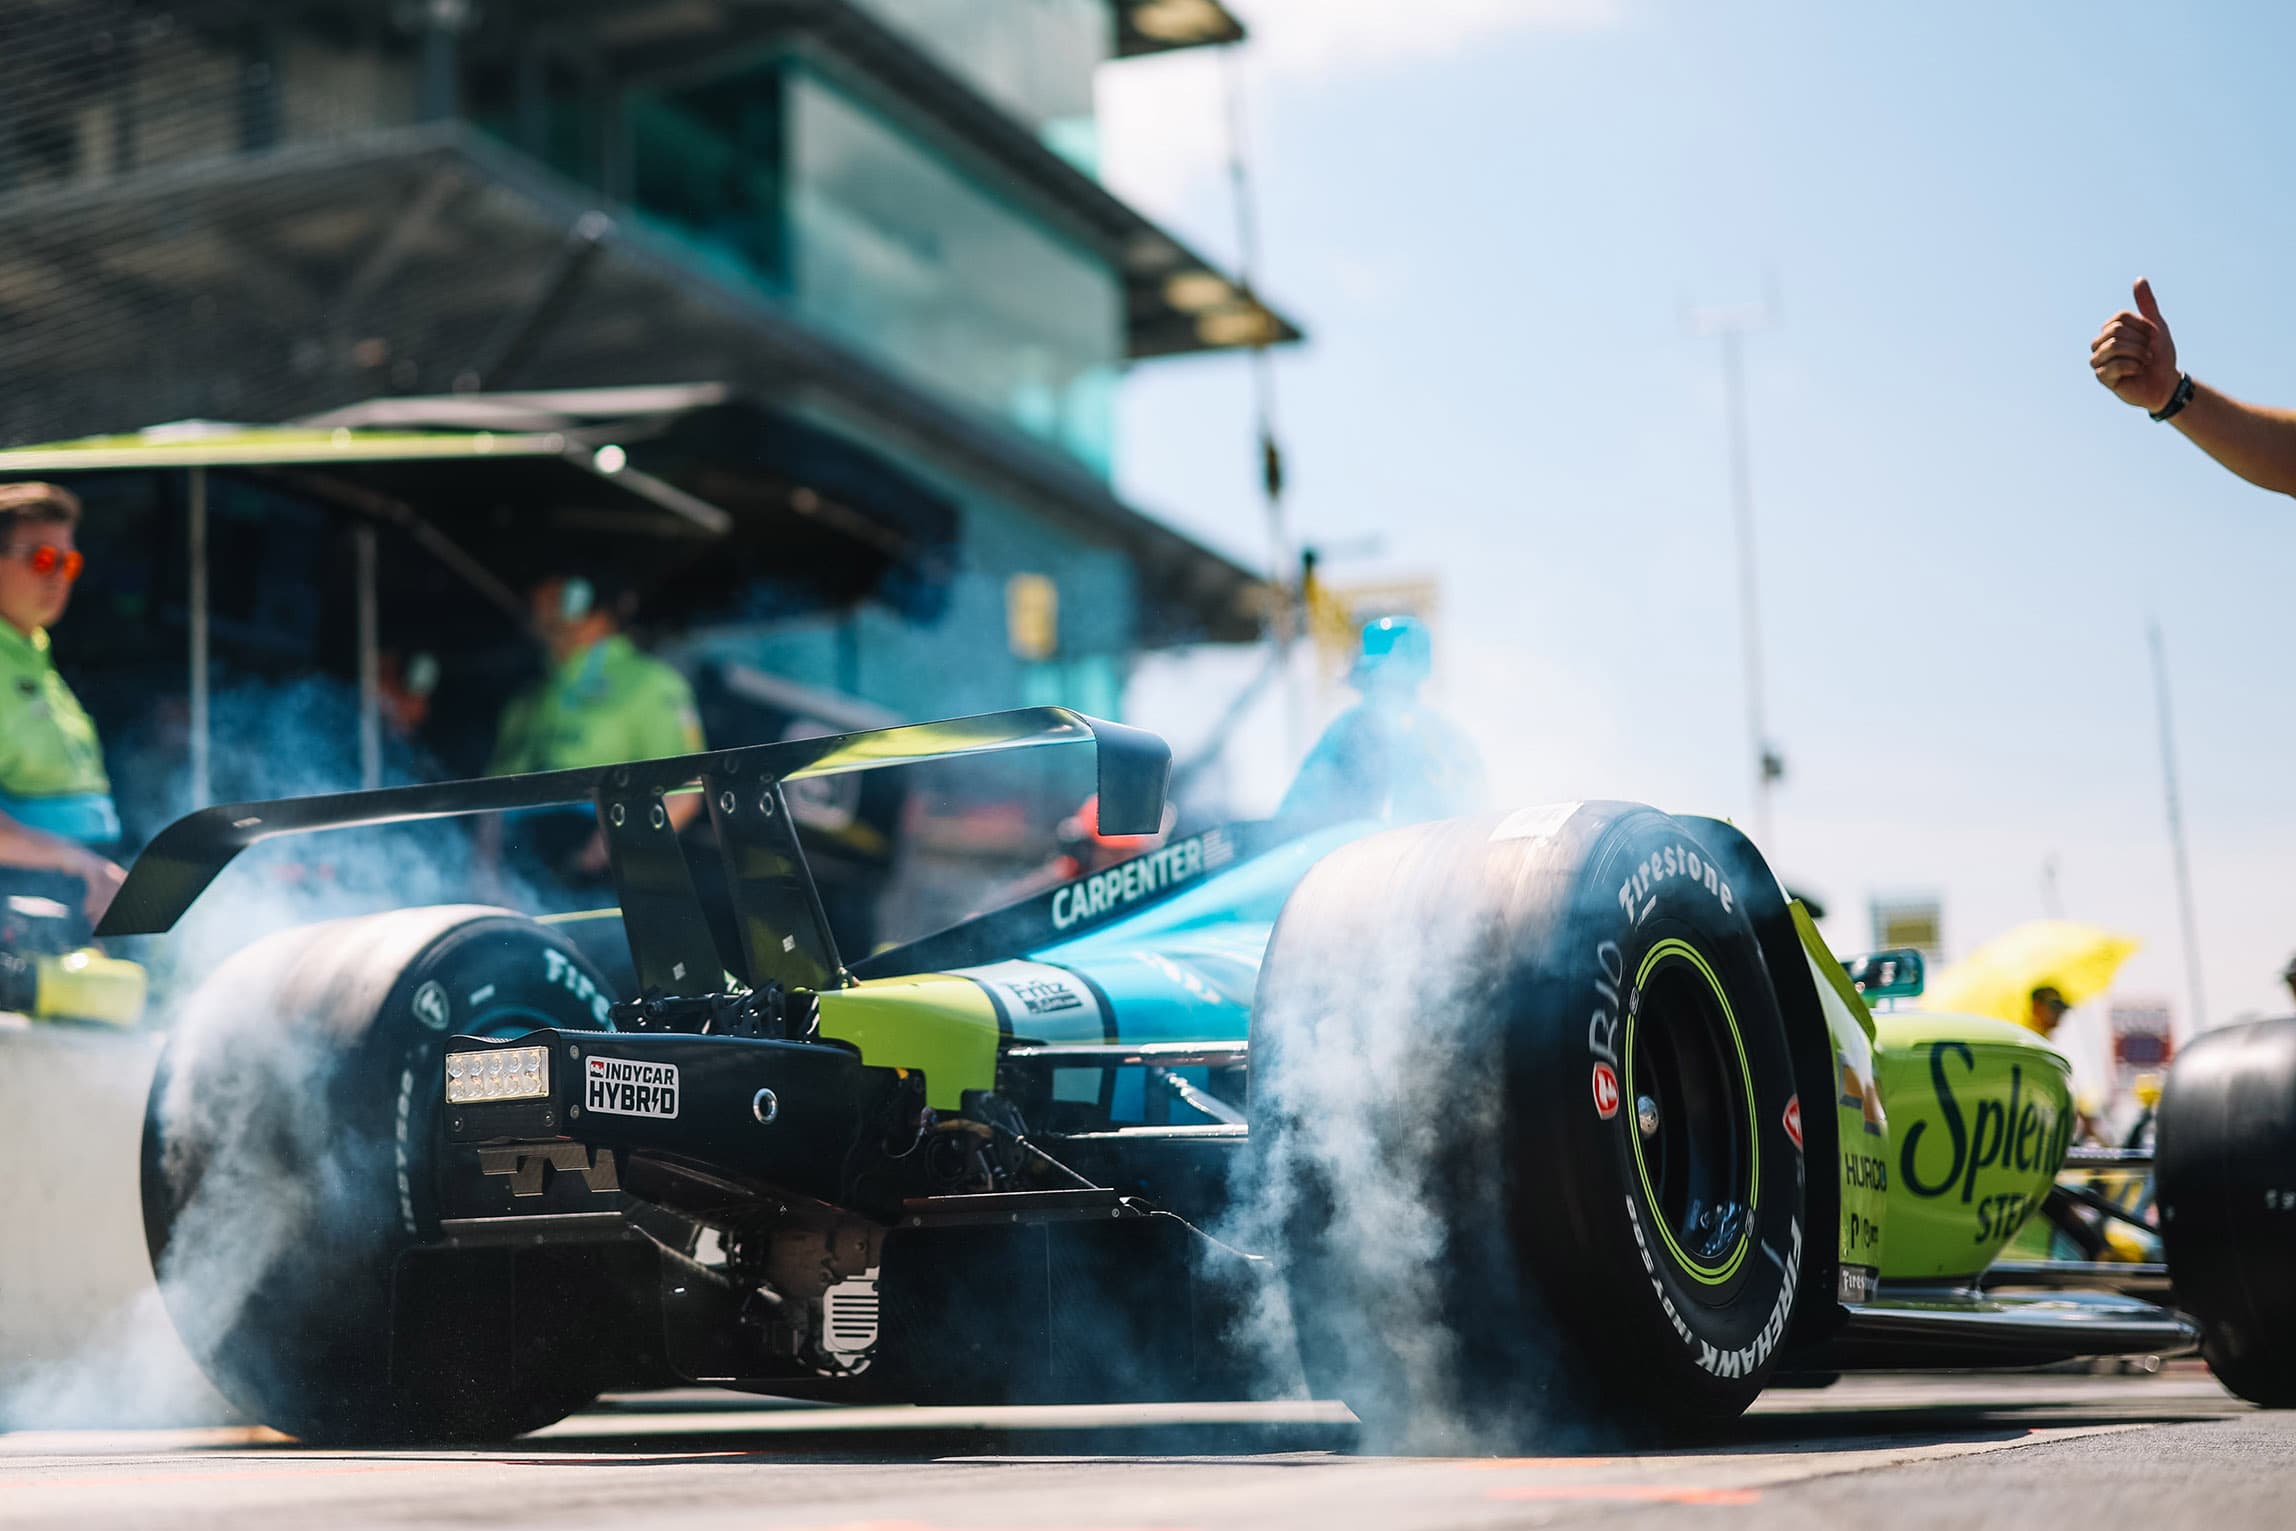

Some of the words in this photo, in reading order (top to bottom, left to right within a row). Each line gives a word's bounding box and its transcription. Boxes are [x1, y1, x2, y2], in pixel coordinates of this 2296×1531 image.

[1051, 837, 1204, 930] CARPENTER
[1618, 844, 1733, 925] Firestone
[589, 1080, 675, 1114] HYBRID
[605, 1062, 675, 1086] INDYCAR
[1845, 1153, 1887, 1192] HURCO
[1695, 1215, 1802, 1379] FIREHAWK
